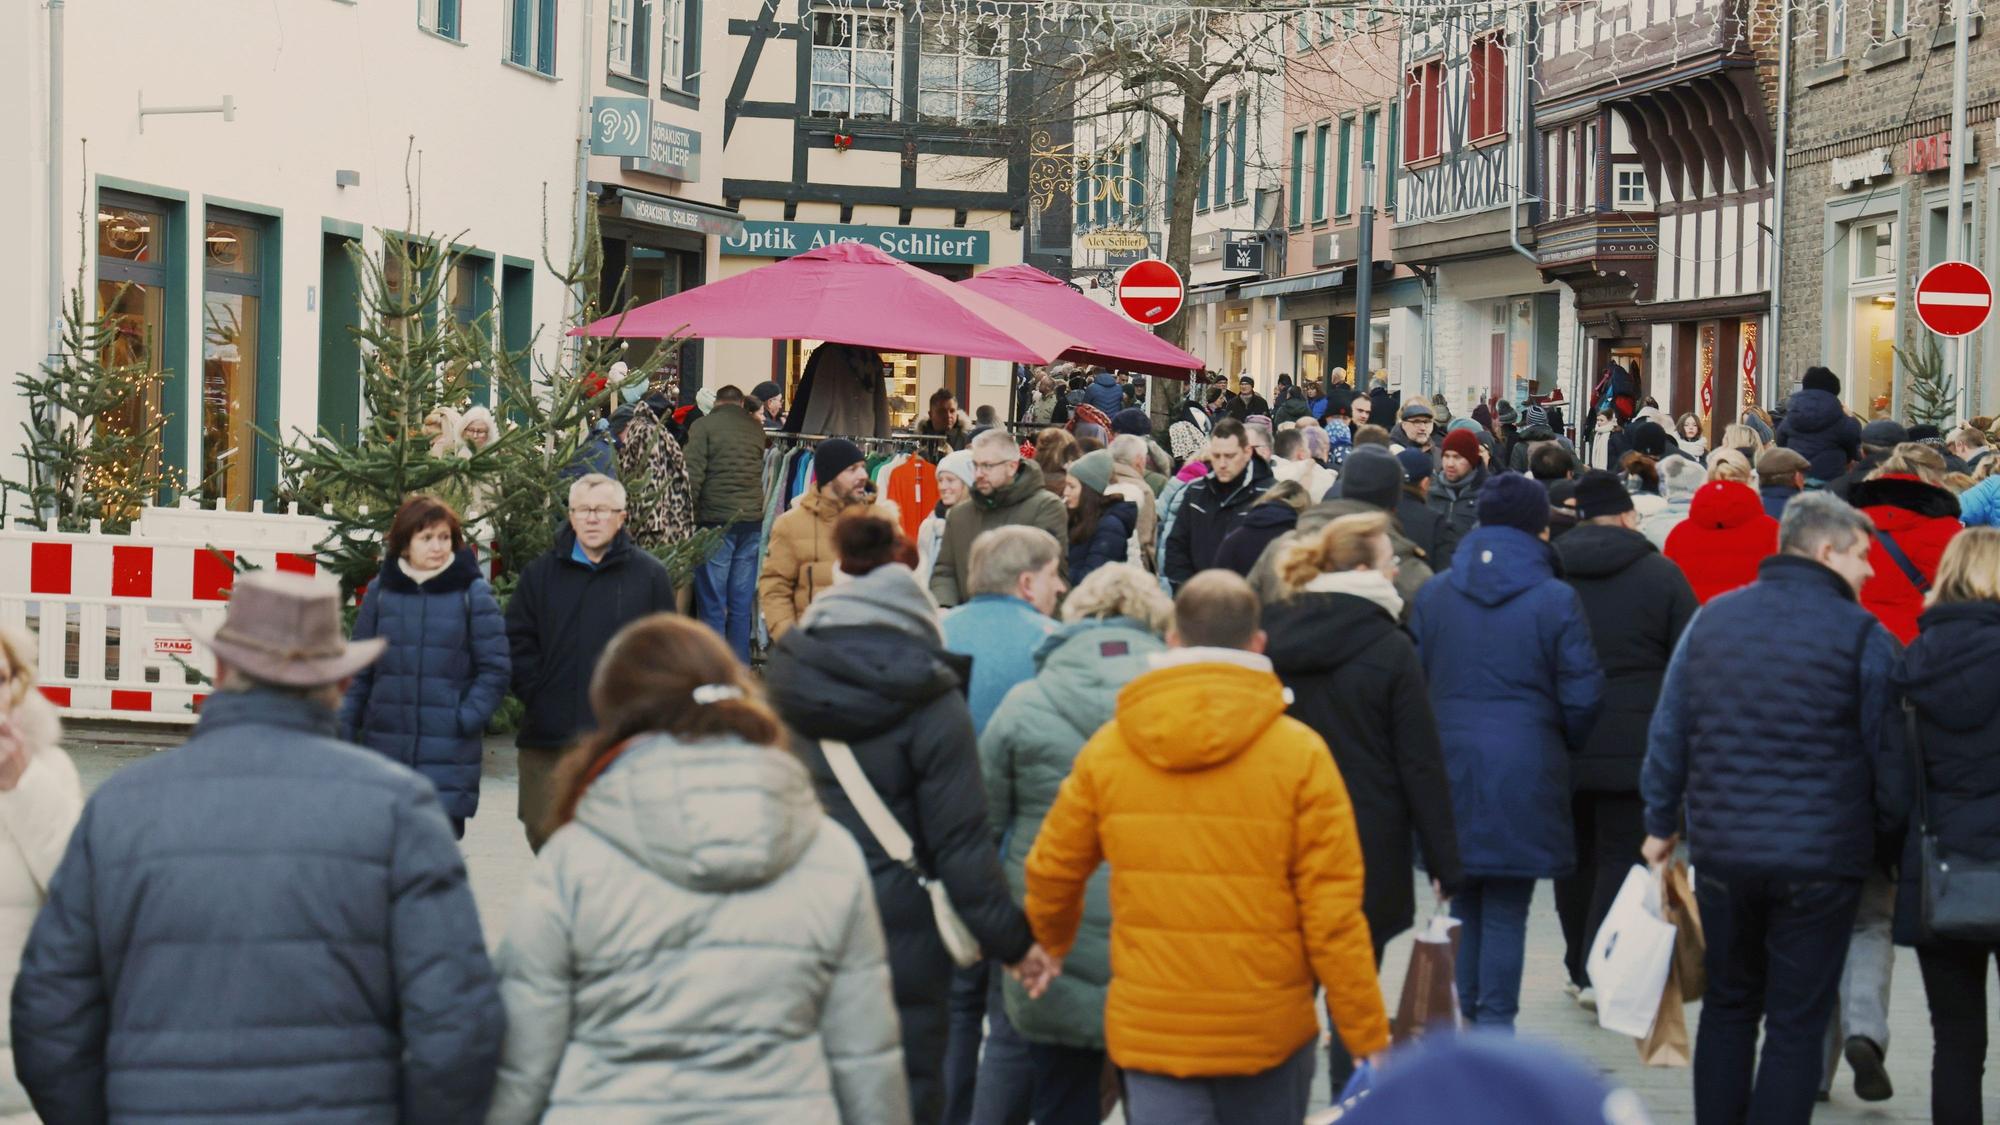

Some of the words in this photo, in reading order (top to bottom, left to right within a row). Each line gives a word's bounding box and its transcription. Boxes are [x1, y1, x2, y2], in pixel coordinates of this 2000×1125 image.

[652, 123, 690, 148] HÖRAKUSTIK
[651, 142, 689, 167] SCHLIERF
[636, 201, 670, 223] HÖRAKUSTIK
[672, 210, 698, 227] SCHLIERF
[725, 227, 797, 252] Optik
[879, 231, 977, 256] Schlierf
[1087, 236, 1106, 247] Alex
[1108, 236, 1143, 247] Schlierf
[154, 641, 192, 650] STRABAG
